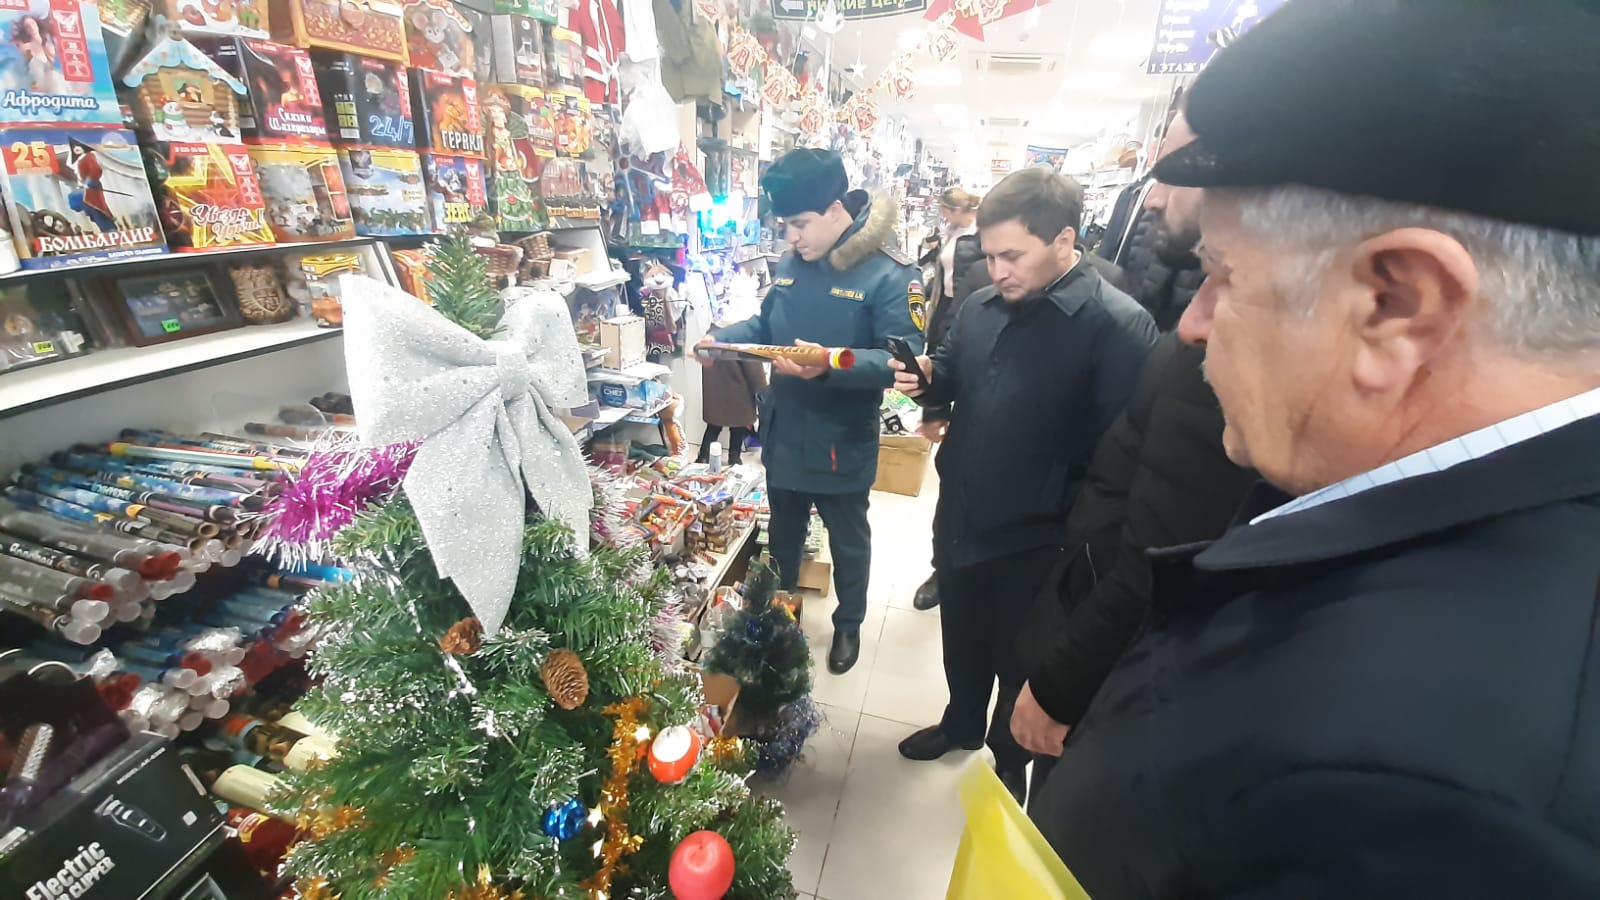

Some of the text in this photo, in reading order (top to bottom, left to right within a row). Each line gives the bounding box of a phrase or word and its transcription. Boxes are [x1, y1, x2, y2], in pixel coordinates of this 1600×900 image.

[807, 0, 867, 10] НИКИЕ
[3, 91, 98, 111] Афродита
[278, 108, 312, 123] Сказки
[368, 115, 414, 144] 24/7
[441, 130, 483, 151] ГЕРАКЛ
[11, 141, 50, 168] 25
[39, 226, 154, 252] БОМБАРДИР
[26, 841, 106, 900] Electric
[69, 857, 116, 898] CLIPPER
